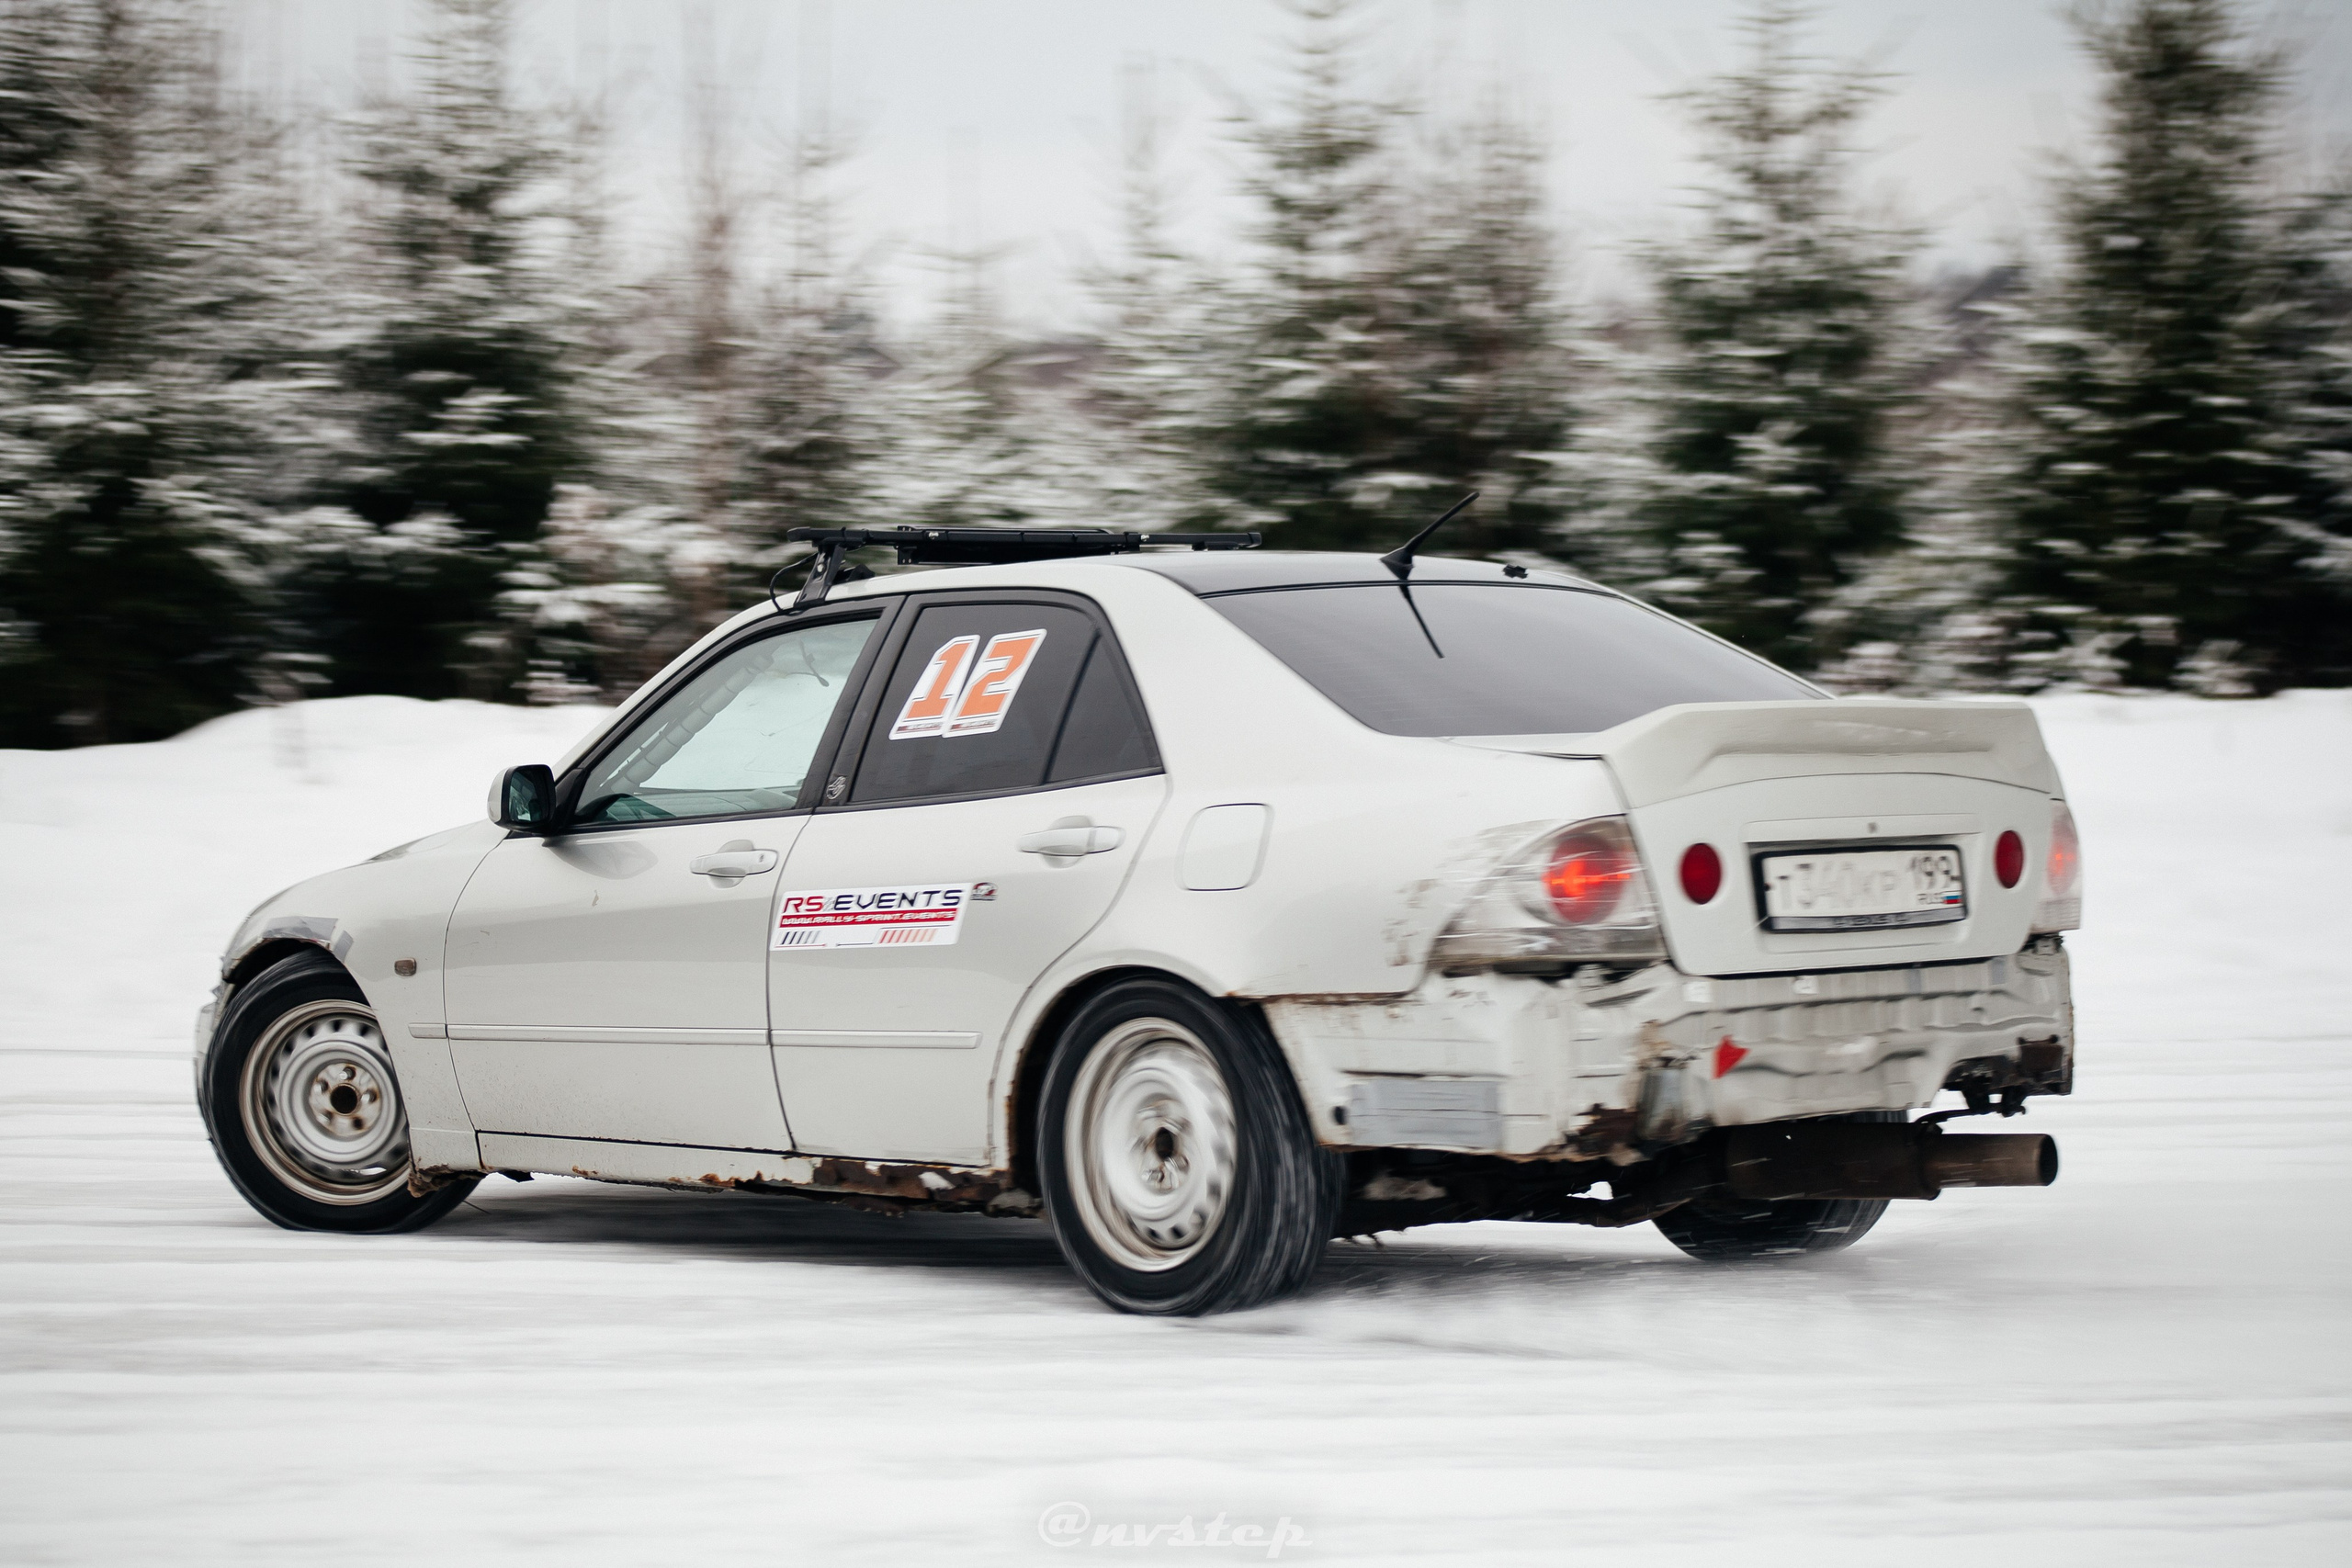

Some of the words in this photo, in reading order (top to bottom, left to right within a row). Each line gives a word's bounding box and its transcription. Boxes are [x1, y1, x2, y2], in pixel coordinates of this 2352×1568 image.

[902, 634, 1041, 721] 12
[1909, 856, 1953, 889] 199
[783, 896, 824, 913] RS
[833, 889, 963, 911] EVENTS
